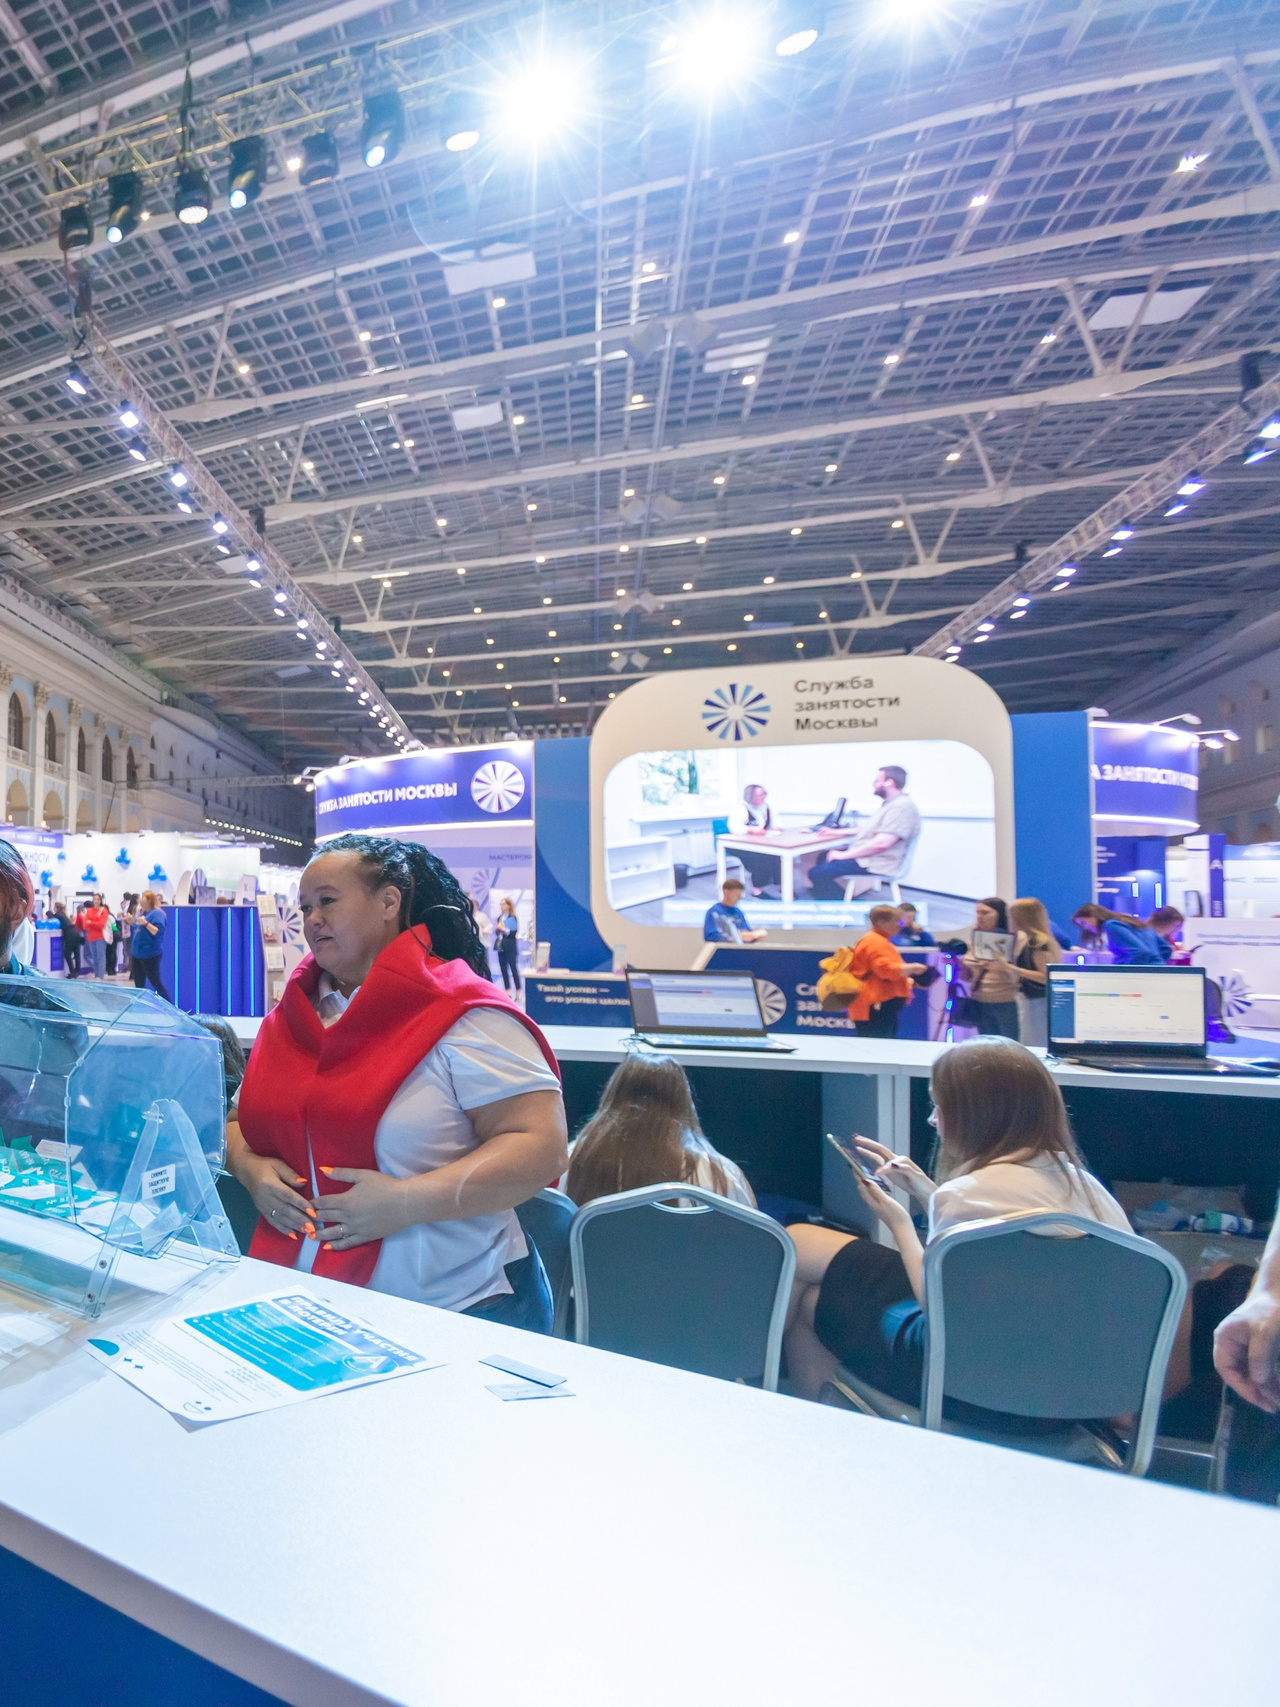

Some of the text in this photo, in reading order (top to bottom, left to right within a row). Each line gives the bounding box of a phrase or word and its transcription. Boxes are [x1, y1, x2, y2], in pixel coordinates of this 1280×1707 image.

[794, 676, 874, 694] Служба
[794, 697, 900, 712] занятости
[795, 718, 878, 731] Москвы
[338, 789, 393, 809] ЗАНЯТОСТИ
[394, 782, 458, 802] МОСКВЫ
[19, 850, 50, 863] ЖНОСТИ
[536, 983, 564, 992] Твой
[565, 986, 598, 994] успех
[565, 996, 598, 1005] успех
[599, 998, 630, 1006] цело
[796, 1014, 856, 1029] Москв
[290, 1297, 353, 1330] ПРАВИЛА
[352, 1328, 419, 1361] УЧАСТИЯ
